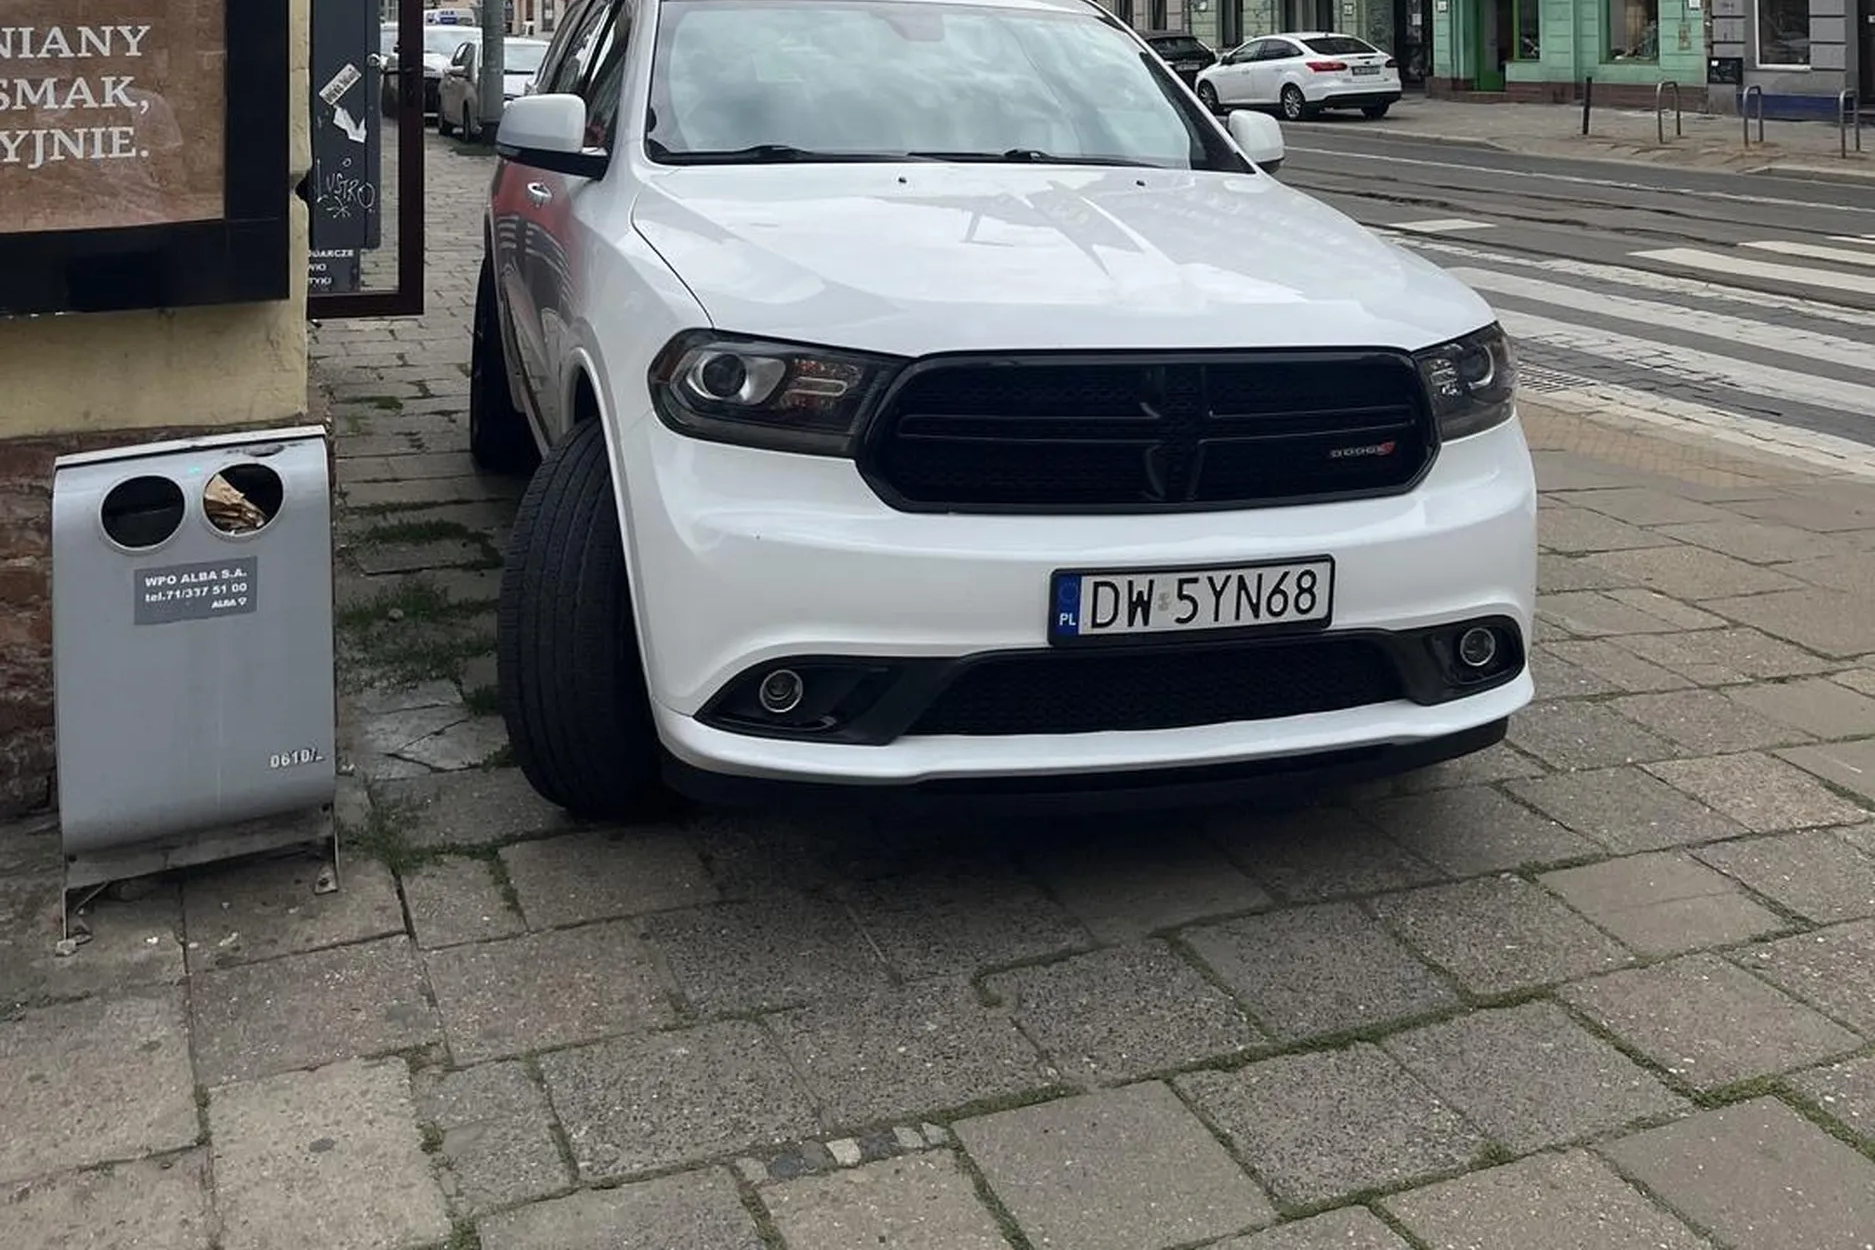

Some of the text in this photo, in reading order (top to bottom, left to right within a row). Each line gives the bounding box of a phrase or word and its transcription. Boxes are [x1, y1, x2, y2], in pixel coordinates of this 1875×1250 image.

[0, 126, 149, 169] YJNIE.
[145, 568, 248, 588] WPO ALBA S.A.
[212, 585, 227, 595] 51
[231, 583, 248, 594] 00
[1091, 569, 1318, 629] DW 5YN68
[1058, 613, 1077, 626] PL
